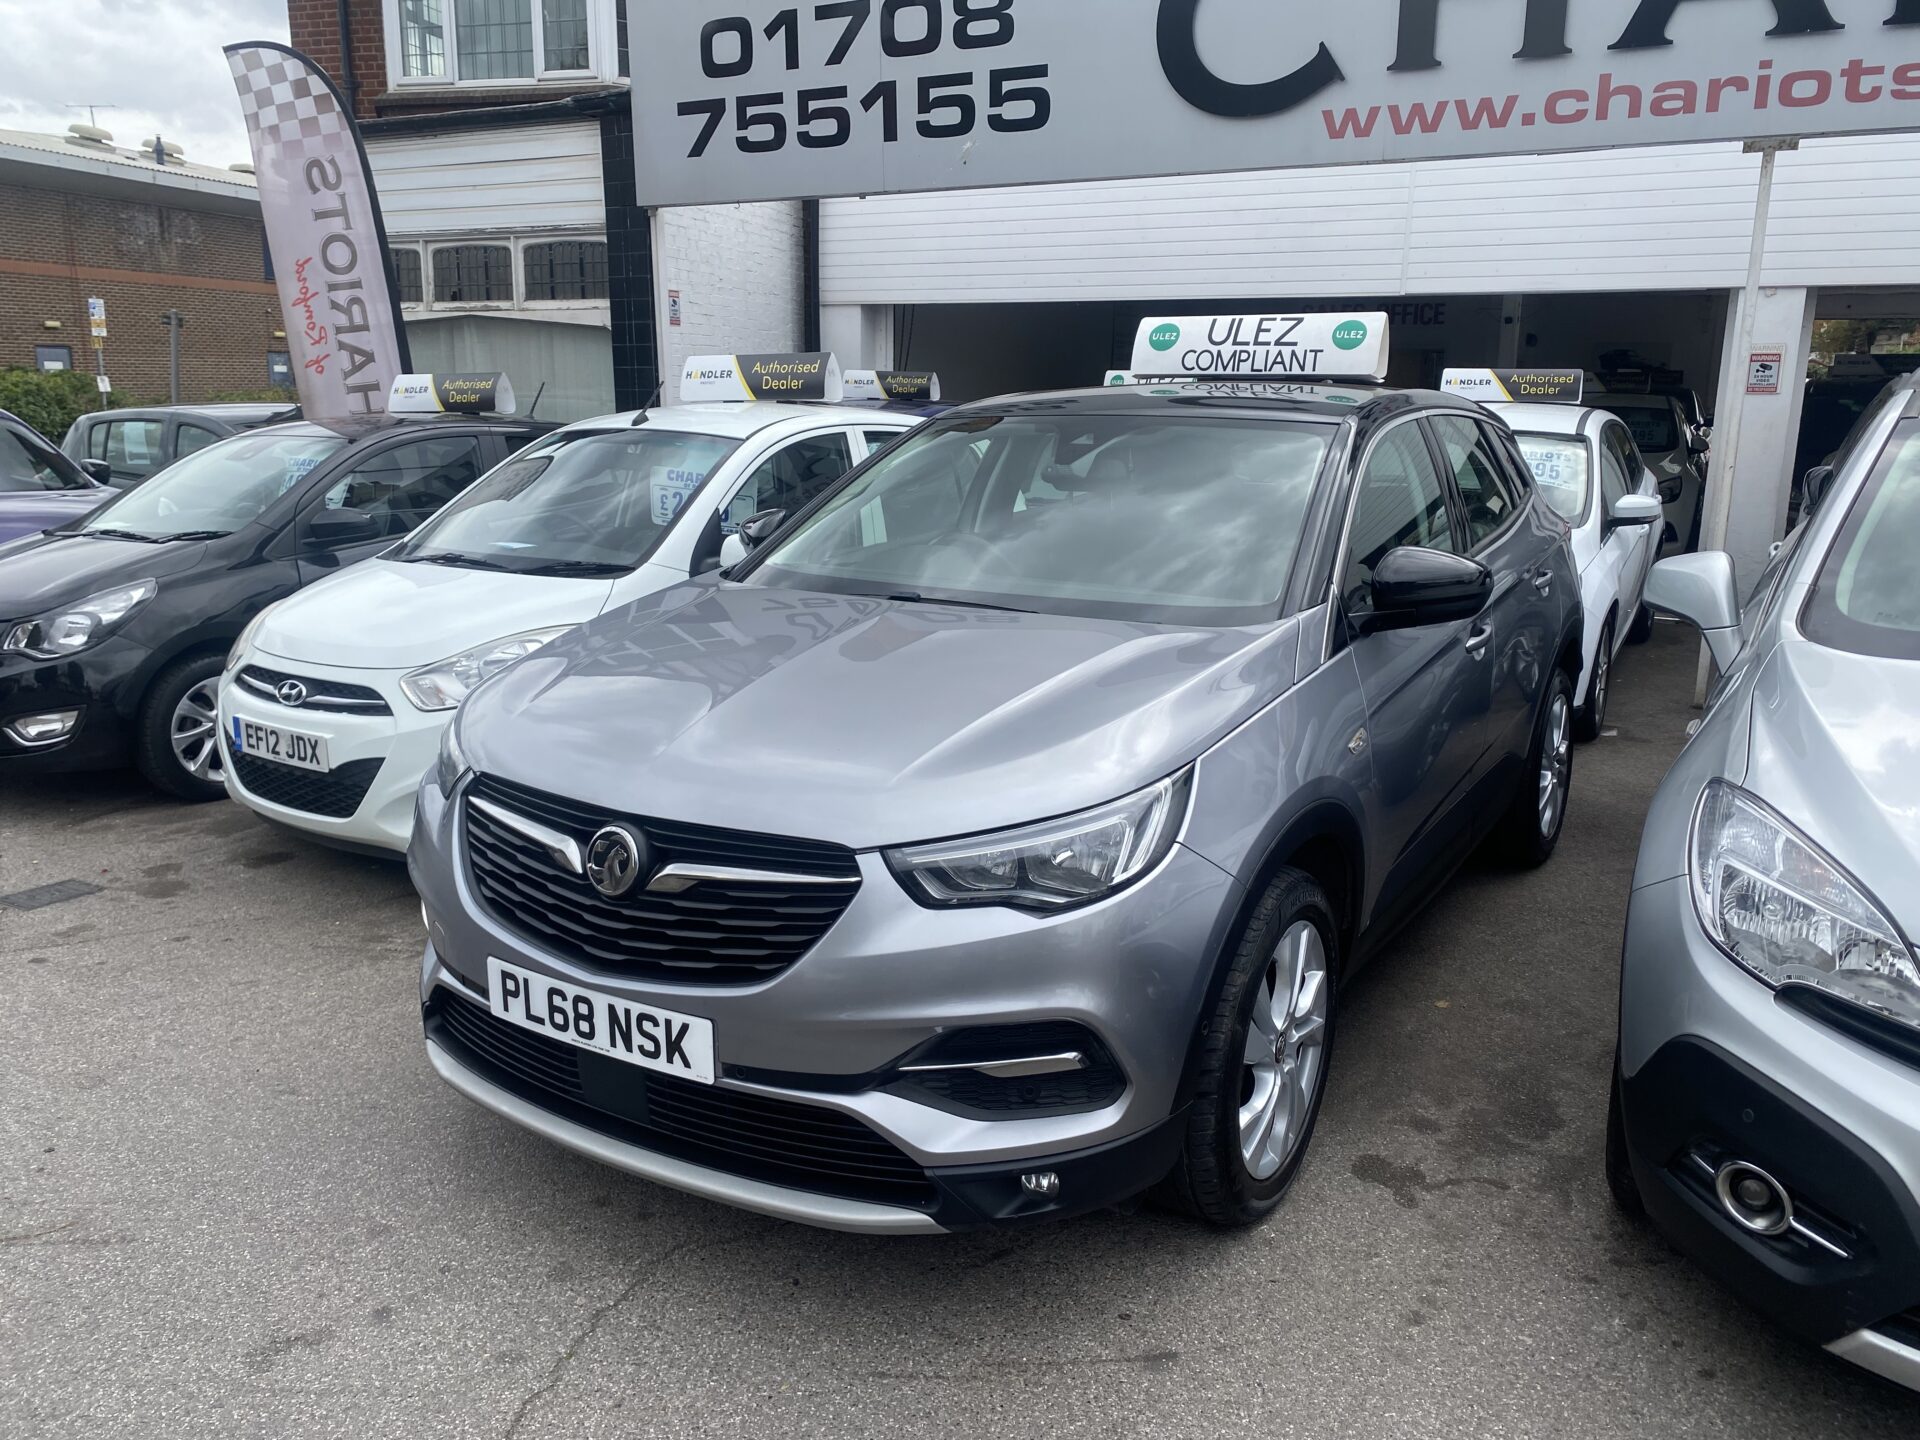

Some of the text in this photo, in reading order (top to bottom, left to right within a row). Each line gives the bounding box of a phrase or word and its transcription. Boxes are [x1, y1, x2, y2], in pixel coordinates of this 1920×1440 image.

[700, 0, 1015, 79] 01708
[676, 63, 1052, 159] 755155
[1152, 332, 1177, 342] ULEZ
[1207, 317, 1305, 347] ULEZ
[1336, 330, 1364, 340] ULEZ
[752, 360, 820, 374] Authorised
[1181, 349, 1324, 373] COMPLIANT
[442, 378, 494, 390] Authorised
[762, 375, 804, 390] Dealer
[886, 375, 928, 384] Authorised
[1510, 374, 1575, 384] Authorised
[892, 384, 918, 393] Dealer
[1520, 384, 1560, 395] Dealer
[449, 391, 480, 403] Dealer
[245, 723, 320, 765] EF12 JDX
[500, 969, 692, 1070] PL68 NSK
